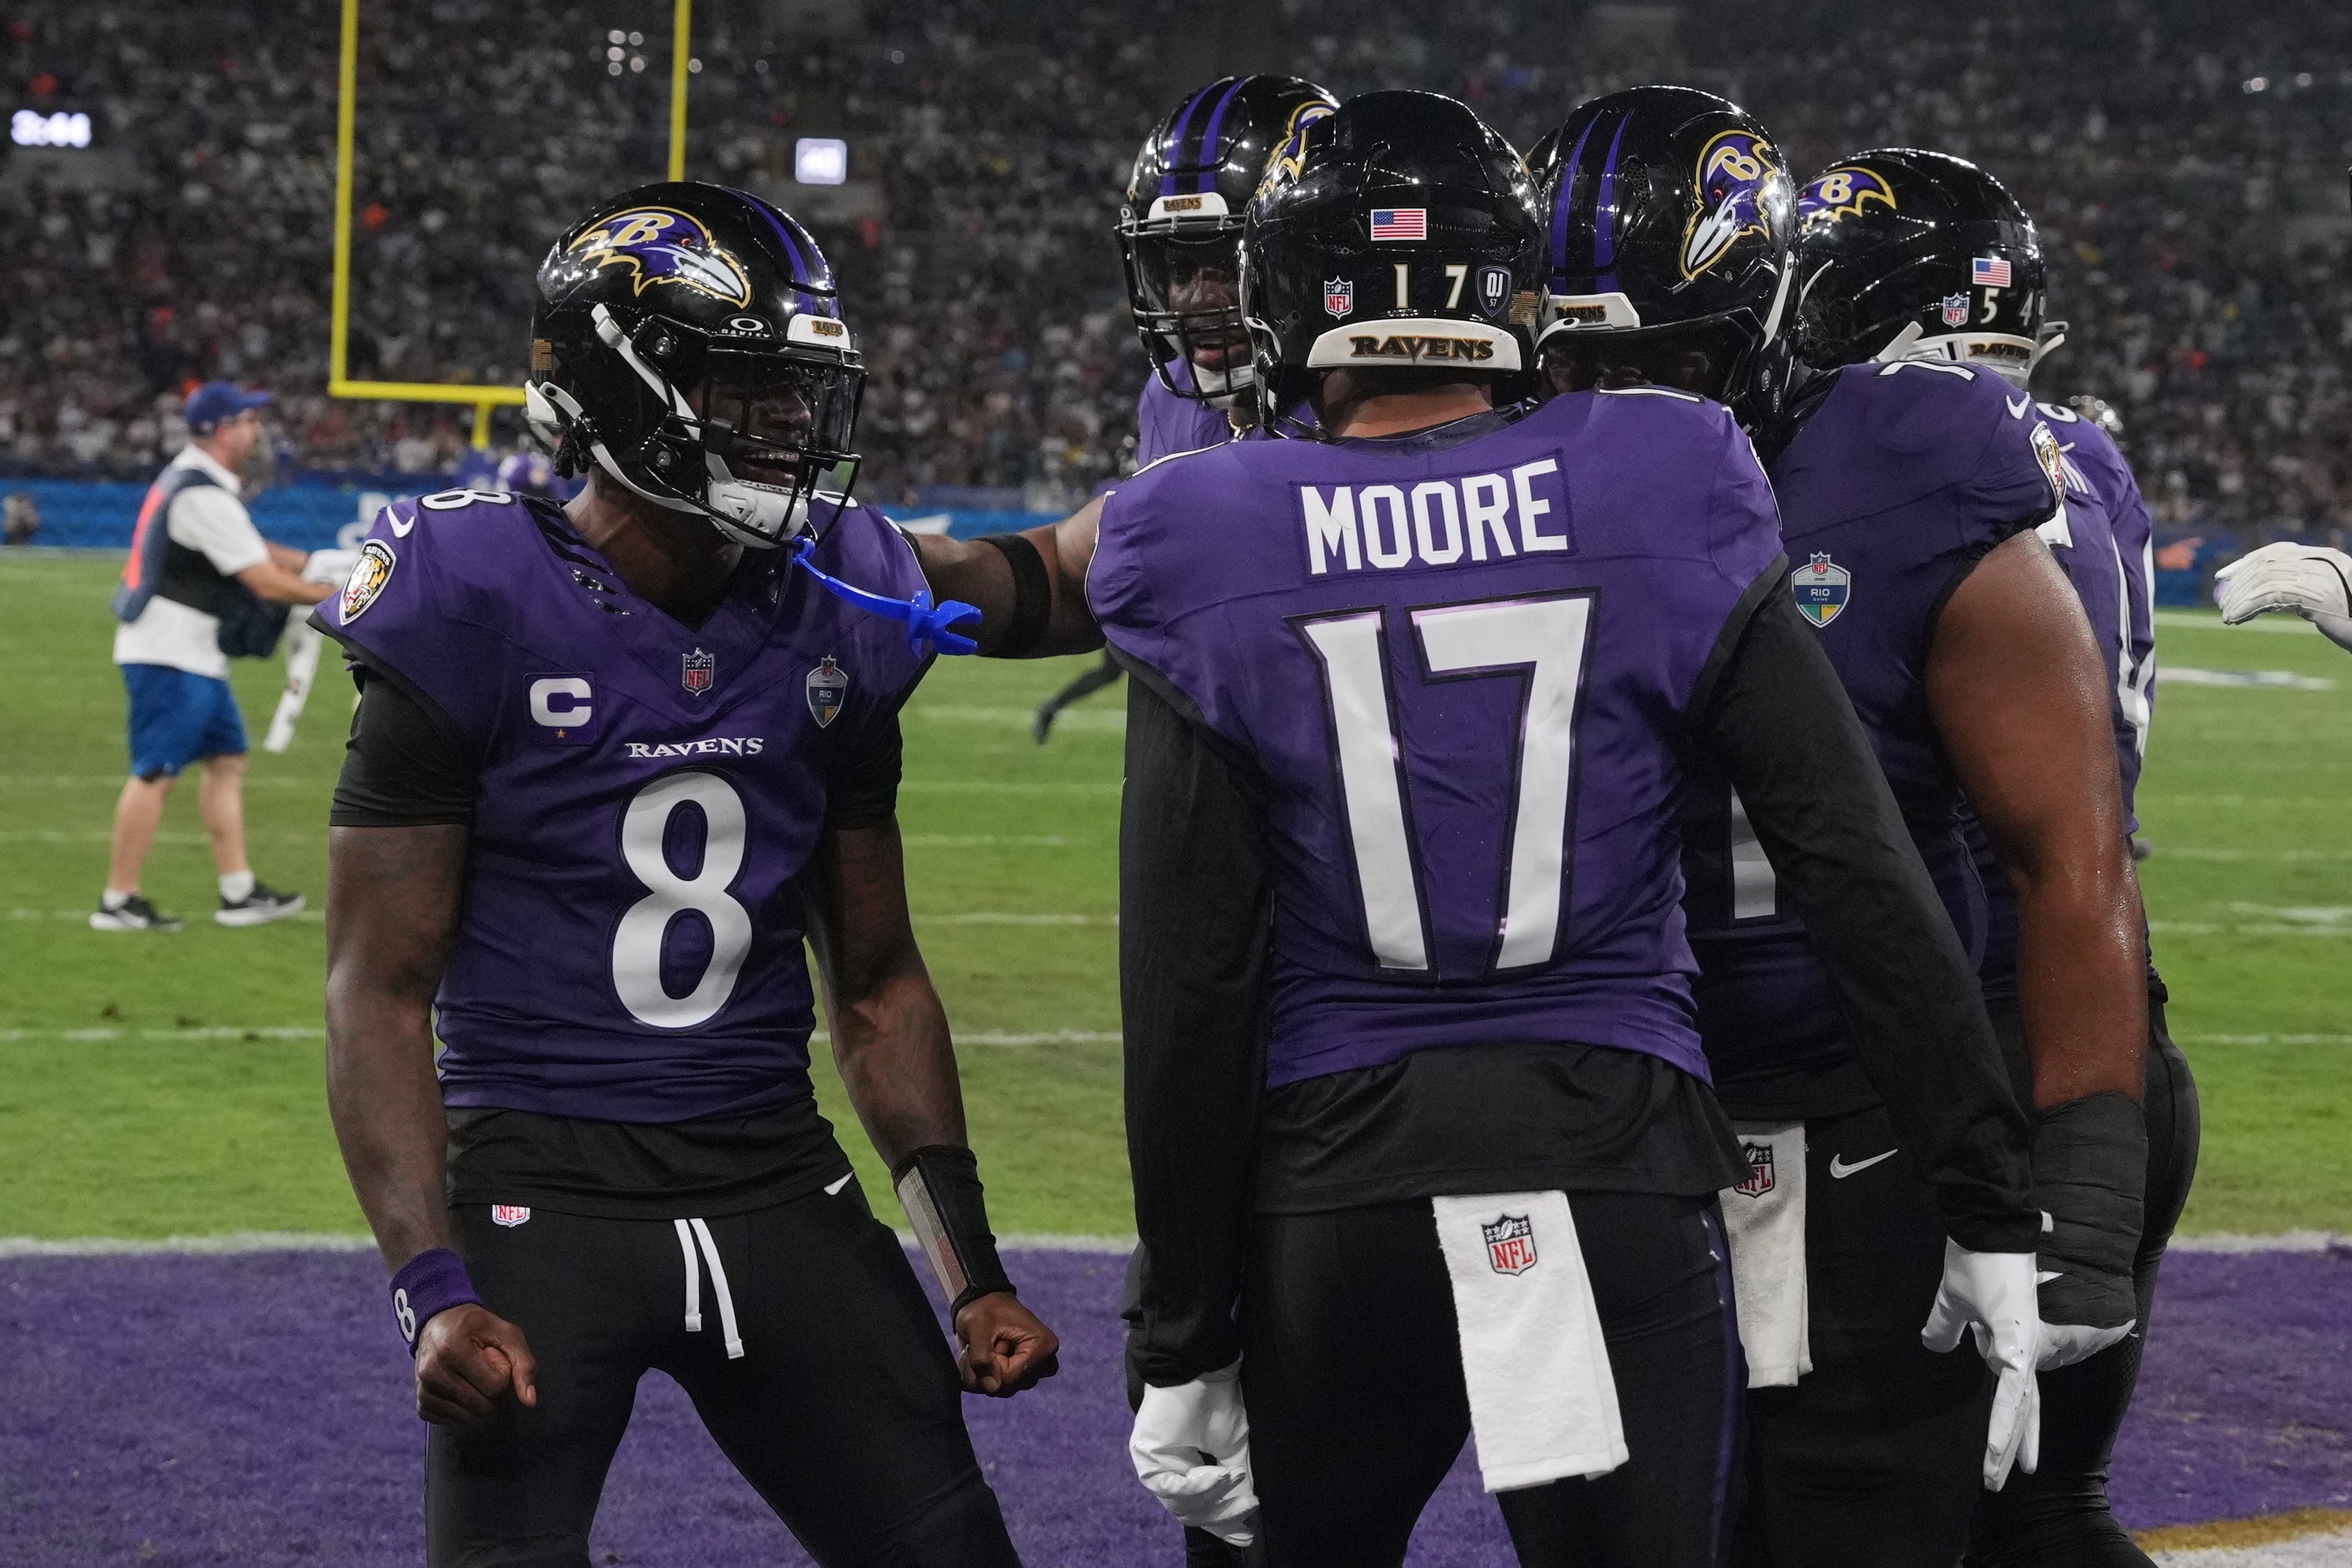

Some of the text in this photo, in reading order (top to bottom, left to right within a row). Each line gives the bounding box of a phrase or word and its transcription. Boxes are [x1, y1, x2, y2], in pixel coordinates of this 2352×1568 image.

[607, 212, 675, 246] B
[1486, 272, 1503, 298] OJ
[1328, 295, 1349, 311] NFL
[1489, 298, 1497, 307] 57
[1554, 303, 1607, 322] RAVENS
[1946, 308, 1966, 321] NFL
[720, 328, 771, 338] OAKLEY
[811, 320, 843, 337] RAVENS
[1348, 335, 1494, 363] RAVENS
[1300, 458, 1567, 575] MOORE
[365, 545, 391, 566] RAVENS
[1811, 588, 1830, 596] RIO
[686, 669, 709, 688] NFL
[529, 677, 592, 727] C
[625, 738, 764, 758] RAVENS
[1301, 594, 1592, 972] 17
[612, 770, 752, 1028] 8
[498, 1204, 524, 1221] NFL
[1492, 1238, 1532, 1269] NFL
[394, 1287, 416, 1343] 8
